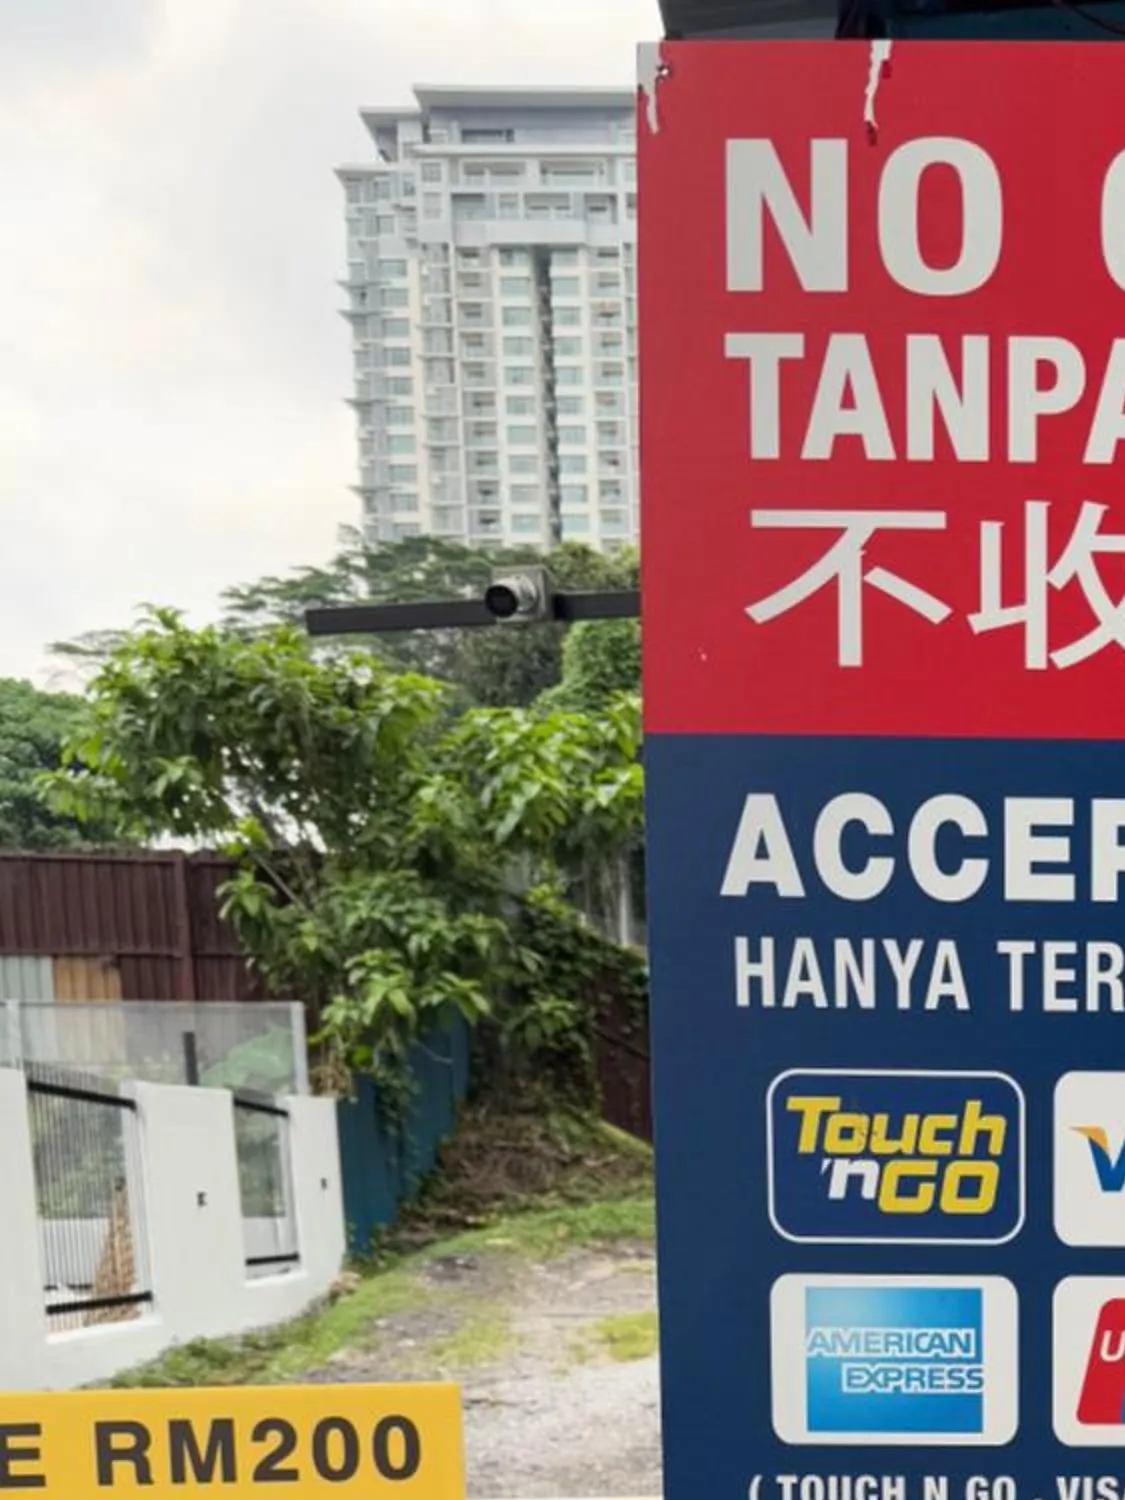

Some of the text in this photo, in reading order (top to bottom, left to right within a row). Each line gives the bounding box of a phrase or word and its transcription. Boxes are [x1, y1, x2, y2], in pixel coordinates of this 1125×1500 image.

[725, 136, 1003, 297] NO
[735, 936, 970, 1010] HANYA
[785, 1096, 1006, 1157] Touch
[807, 1330, 973, 1357] AMERICAN
[844, 1365, 984, 1391] EXPRESS
[95, 1415, 421, 1486] RM200
